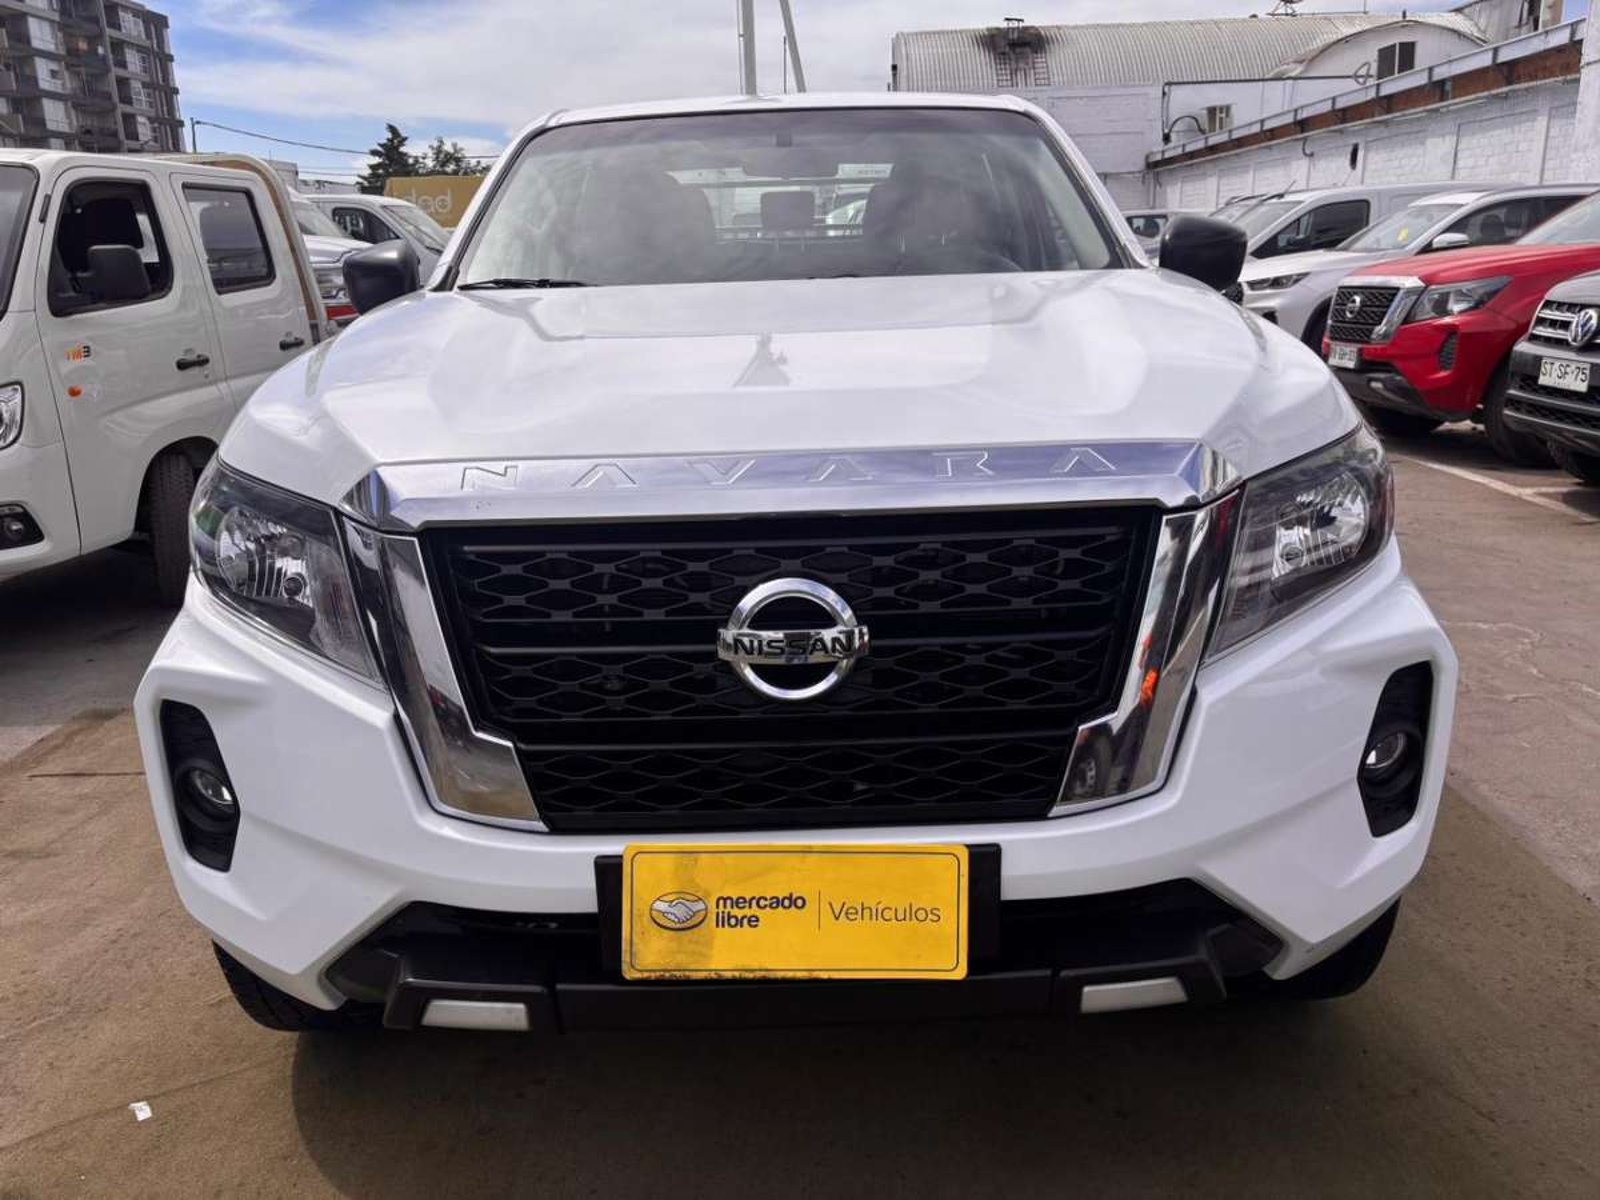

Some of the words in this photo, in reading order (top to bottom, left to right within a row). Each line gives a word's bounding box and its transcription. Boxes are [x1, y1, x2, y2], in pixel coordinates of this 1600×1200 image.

[460, 447, 1116, 491] NAVARA
[733, 635, 852, 657] NISSAN
[715, 892, 806, 911] mercado
[828, 900, 941, 923] Vehículos
[715, 911, 760, 929] libre
